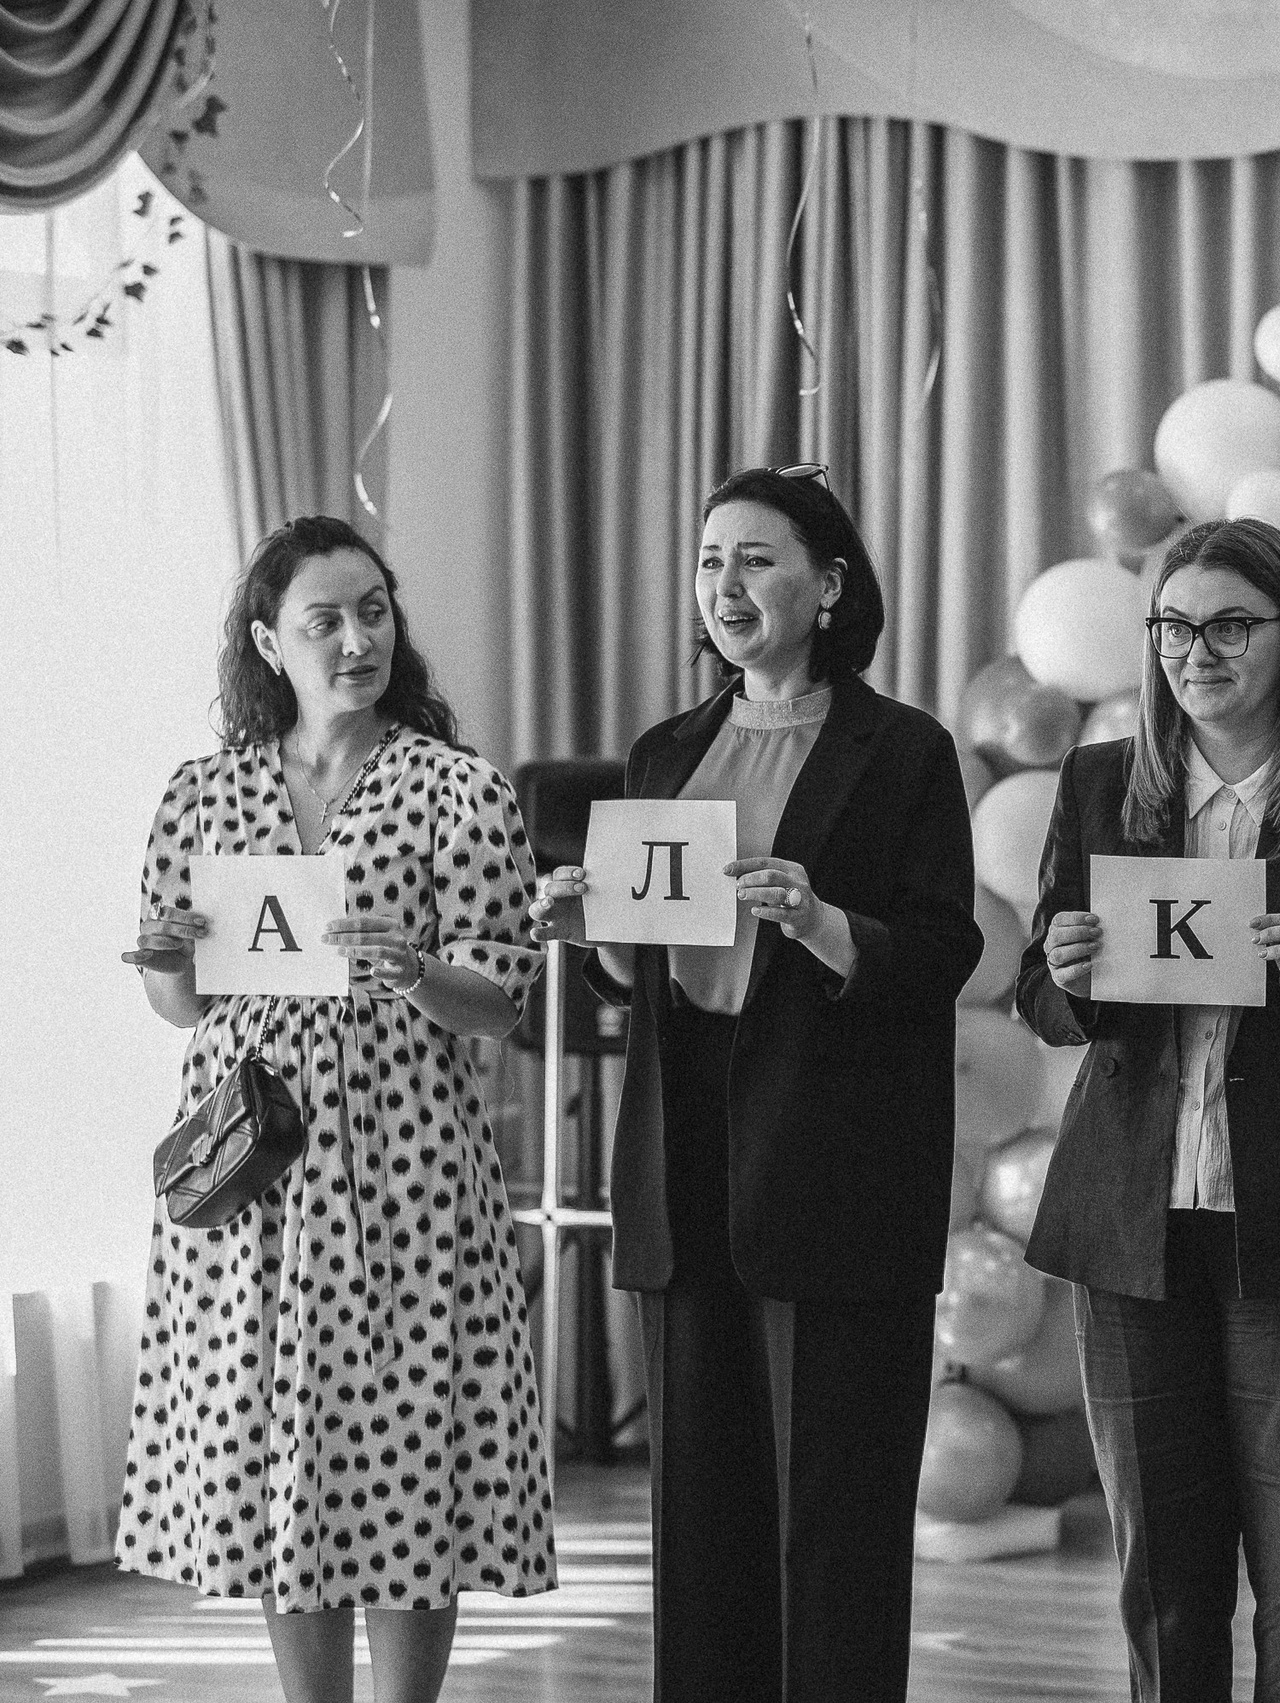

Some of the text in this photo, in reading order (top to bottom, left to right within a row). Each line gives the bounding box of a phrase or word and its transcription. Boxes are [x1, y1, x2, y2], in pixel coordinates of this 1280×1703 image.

[631, 840, 691, 901] Л
[248, 894, 303, 952] А
[1148, 898, 1215, 961] К
